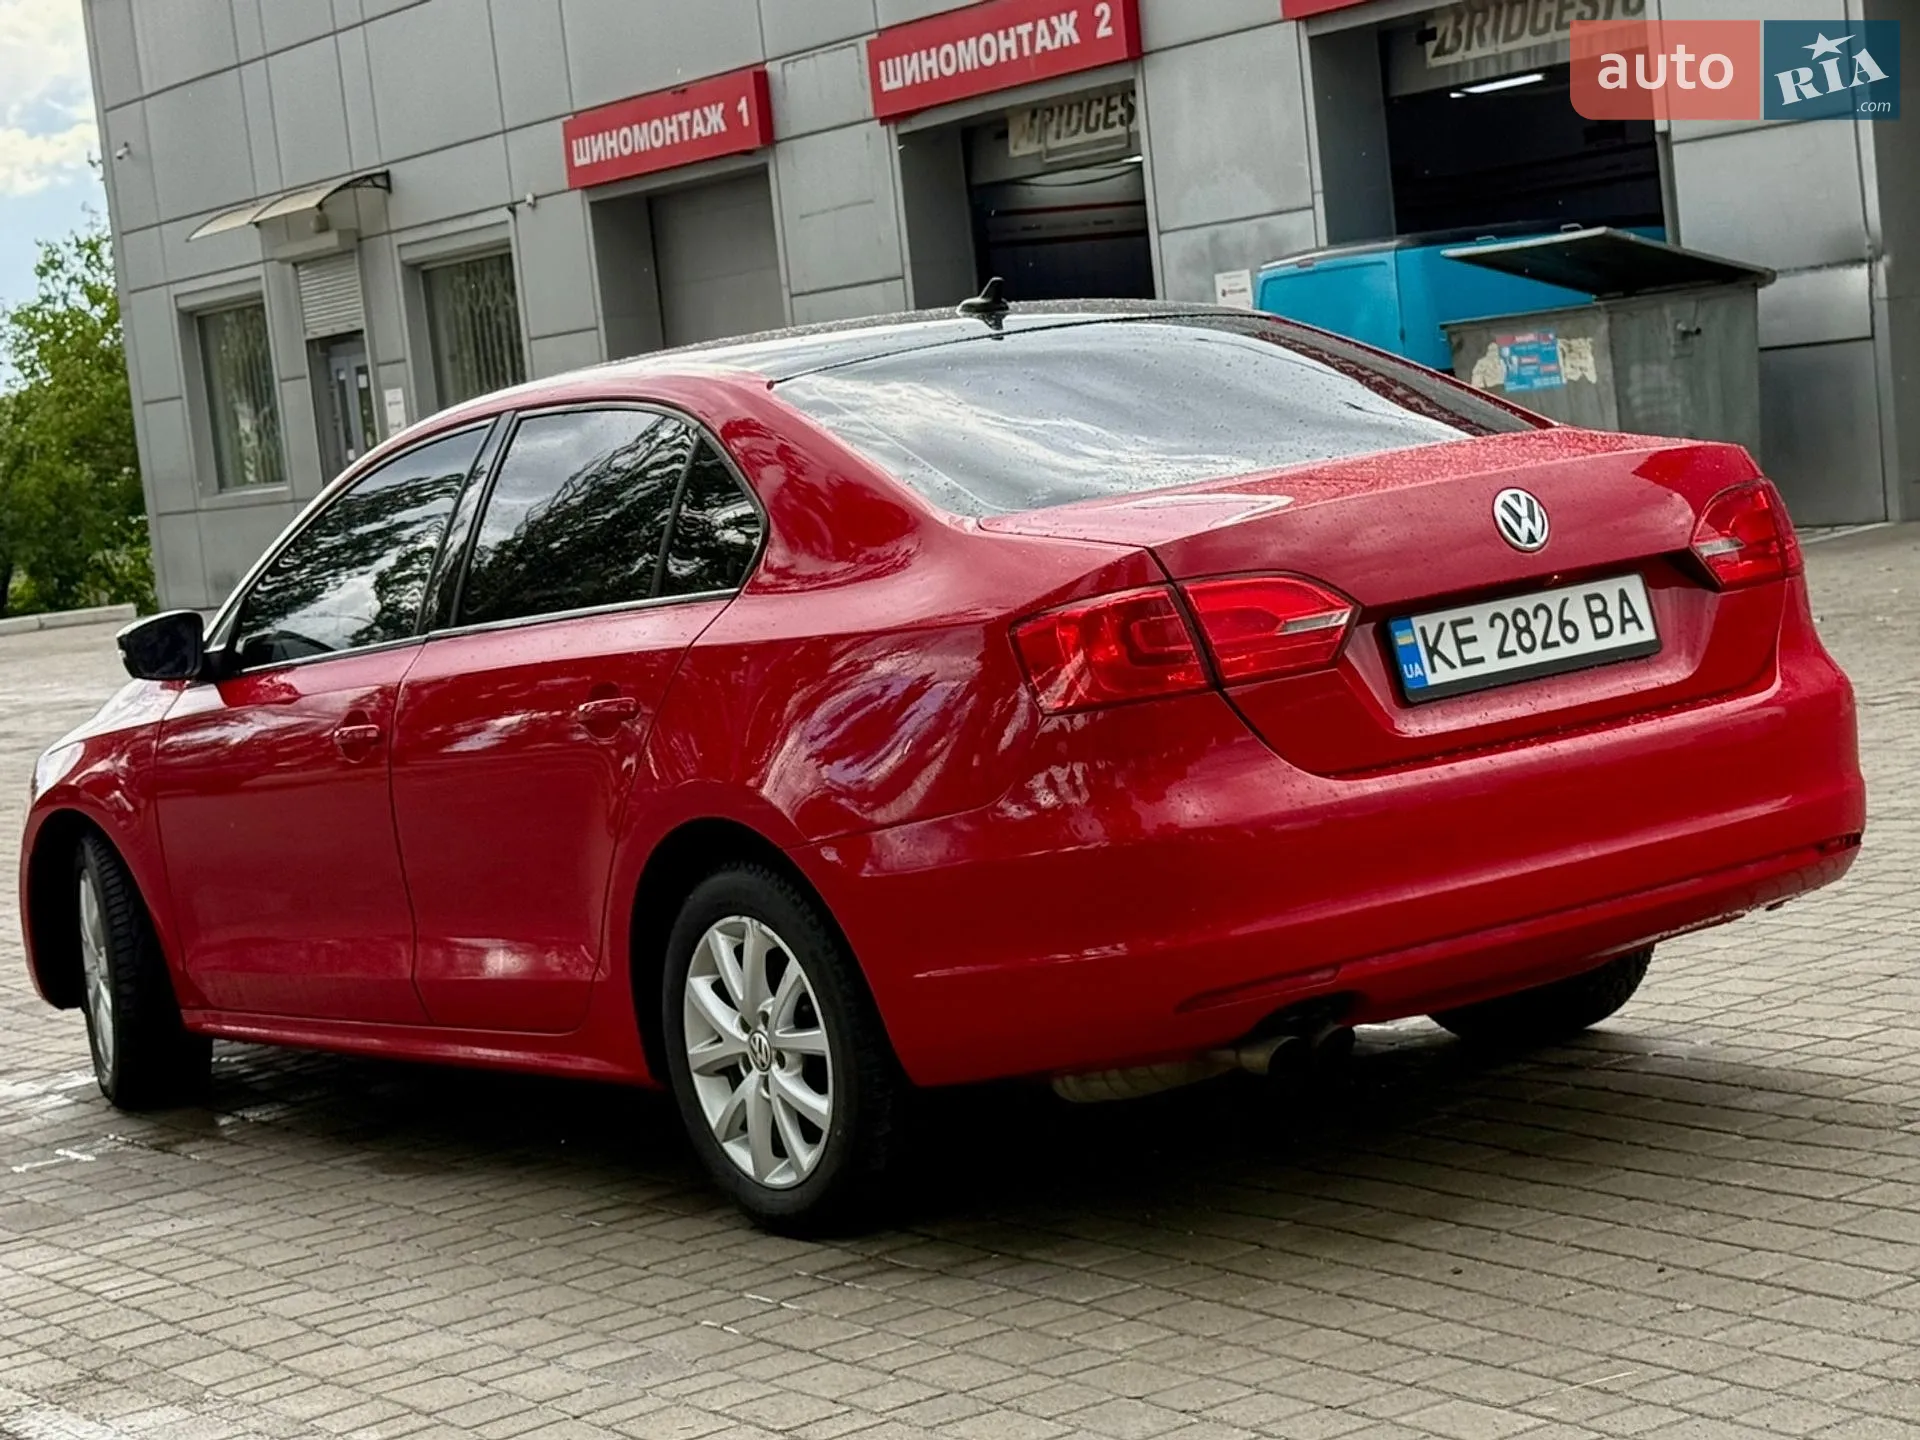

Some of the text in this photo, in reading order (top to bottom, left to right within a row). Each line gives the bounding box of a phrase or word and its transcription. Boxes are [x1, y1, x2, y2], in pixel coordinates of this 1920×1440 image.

[878, 2, 1113, 92] ШИНОМОНТАЖ 2
[572, 96, 750, 167] ШИНОМОНТАЖ 1
[1419, 587, 1645, 674] KE 2826 BA
[1403, 663, 1424, 680] UA
